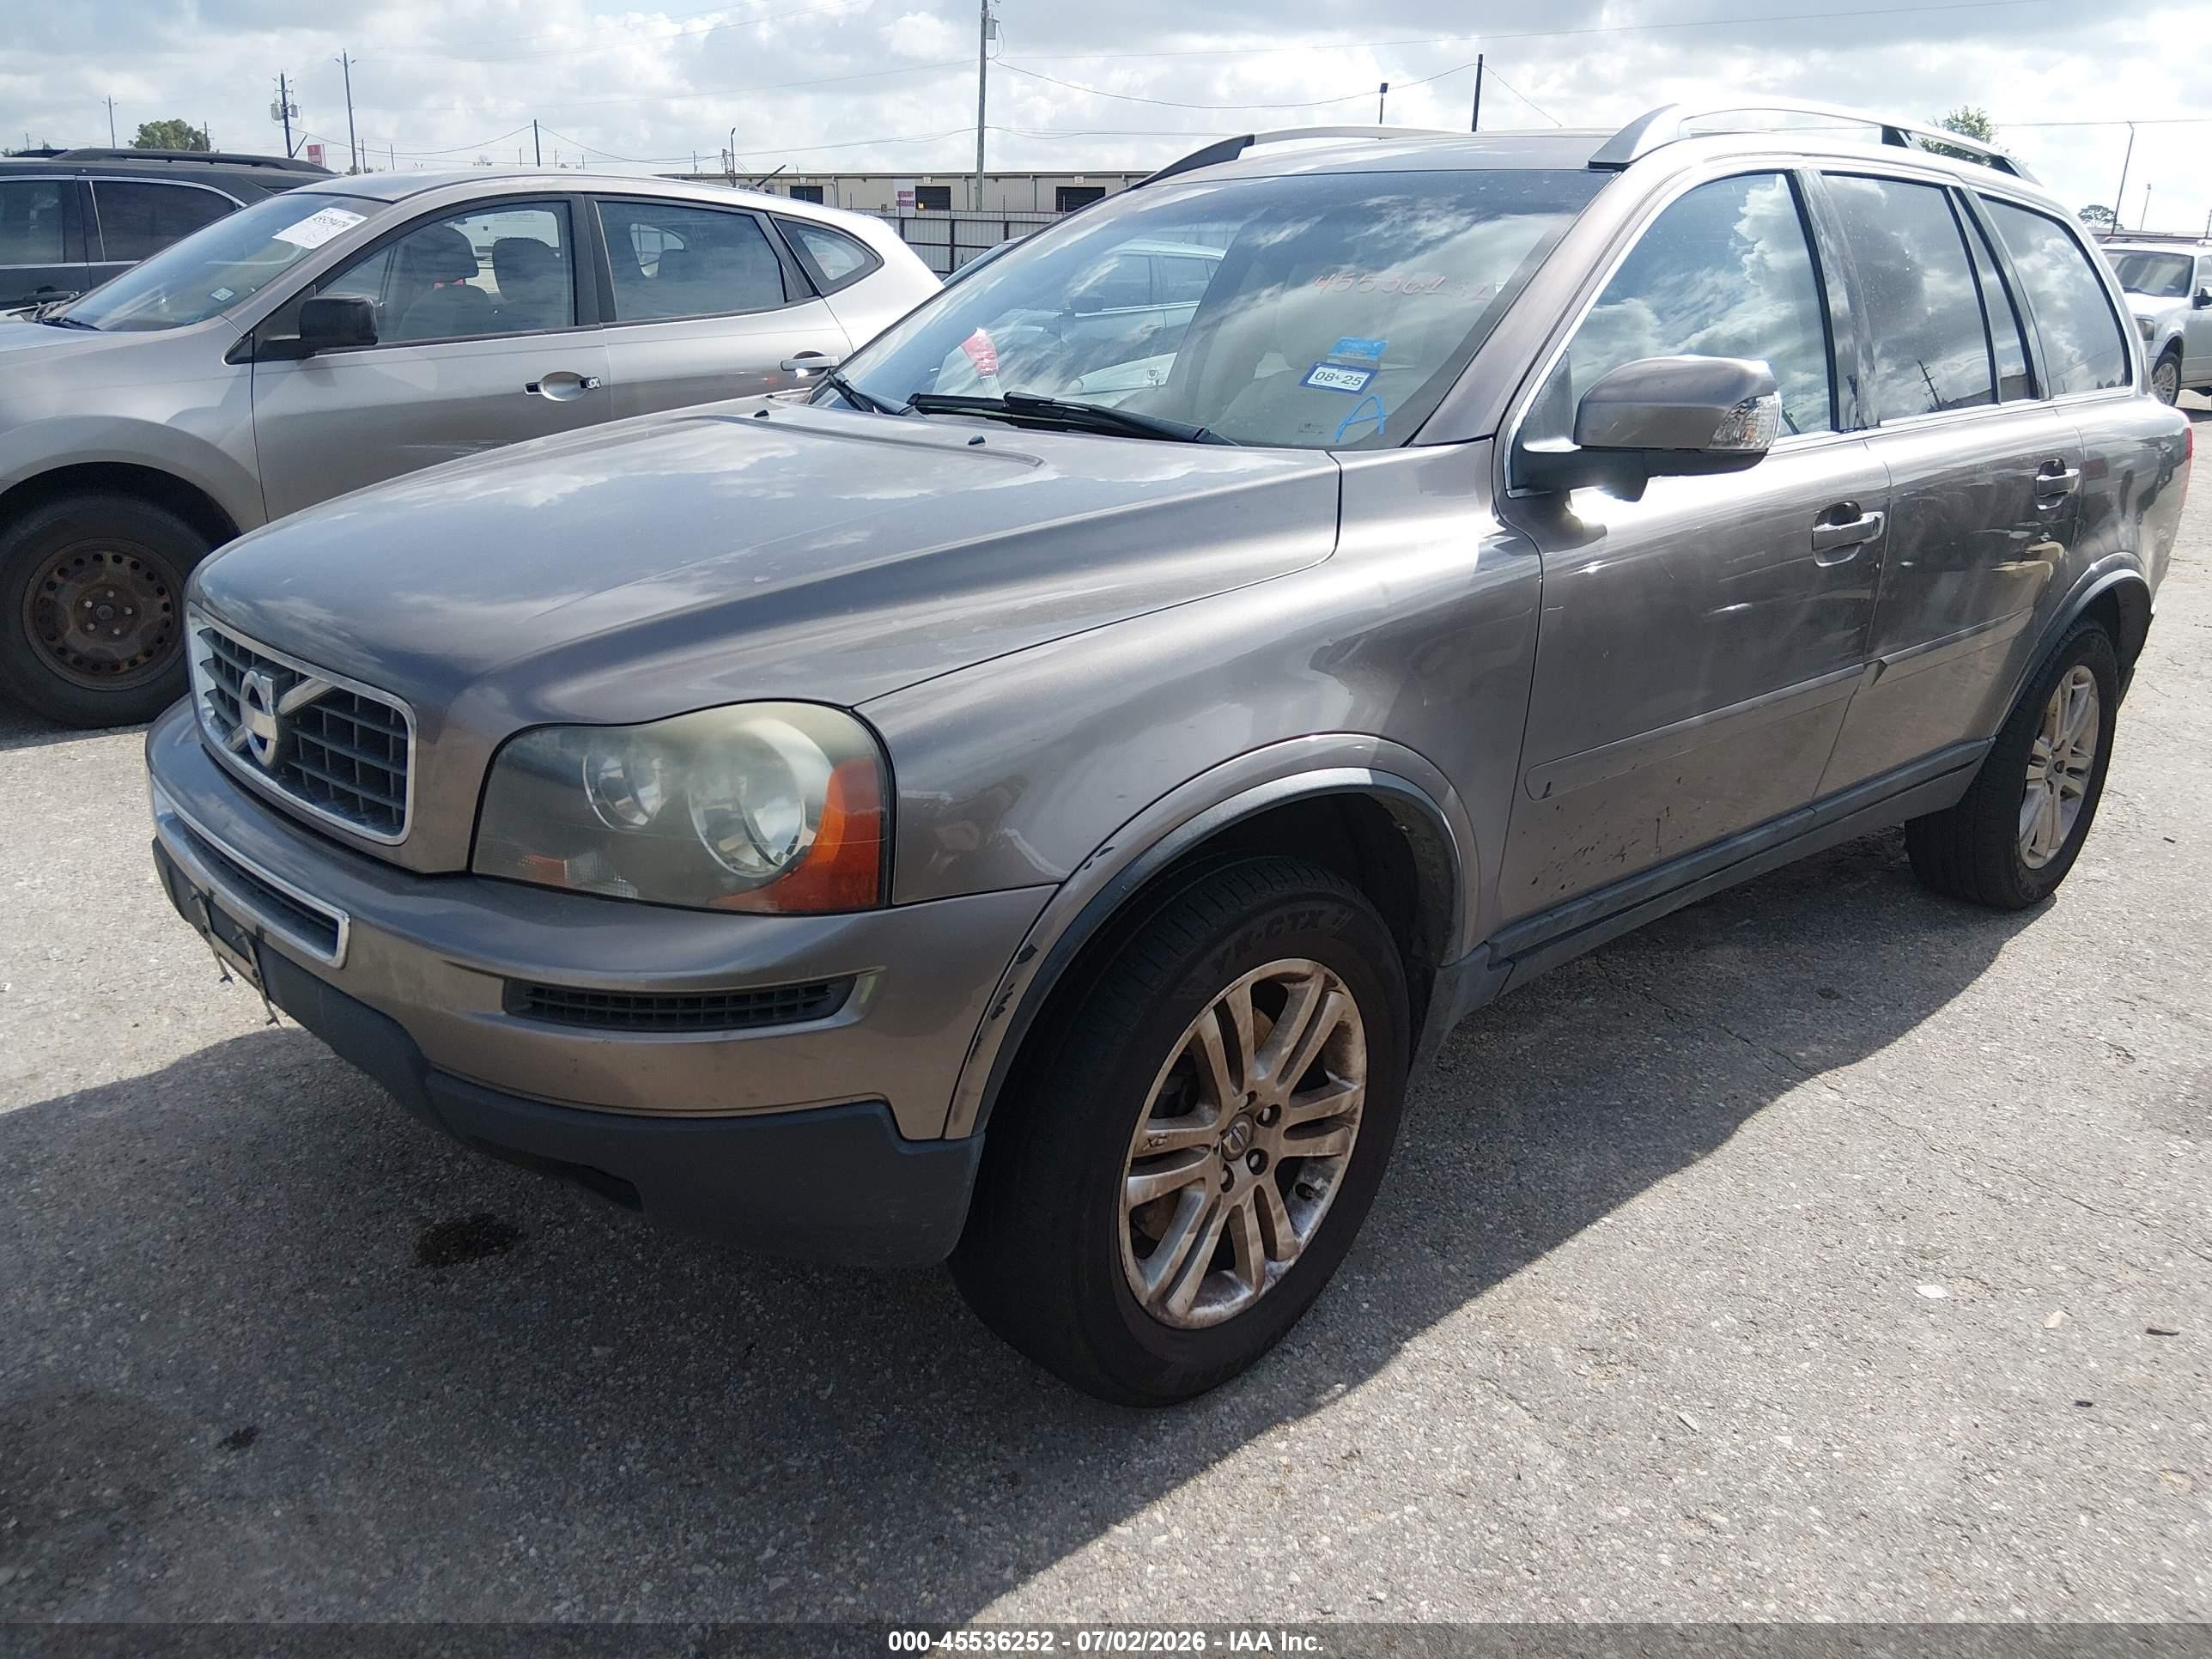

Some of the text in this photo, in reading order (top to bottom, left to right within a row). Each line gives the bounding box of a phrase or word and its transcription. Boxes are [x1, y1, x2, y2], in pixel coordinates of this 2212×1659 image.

[1314, 371, 1364, 386] 08 25
[1334, 396, 1388, 441] A
